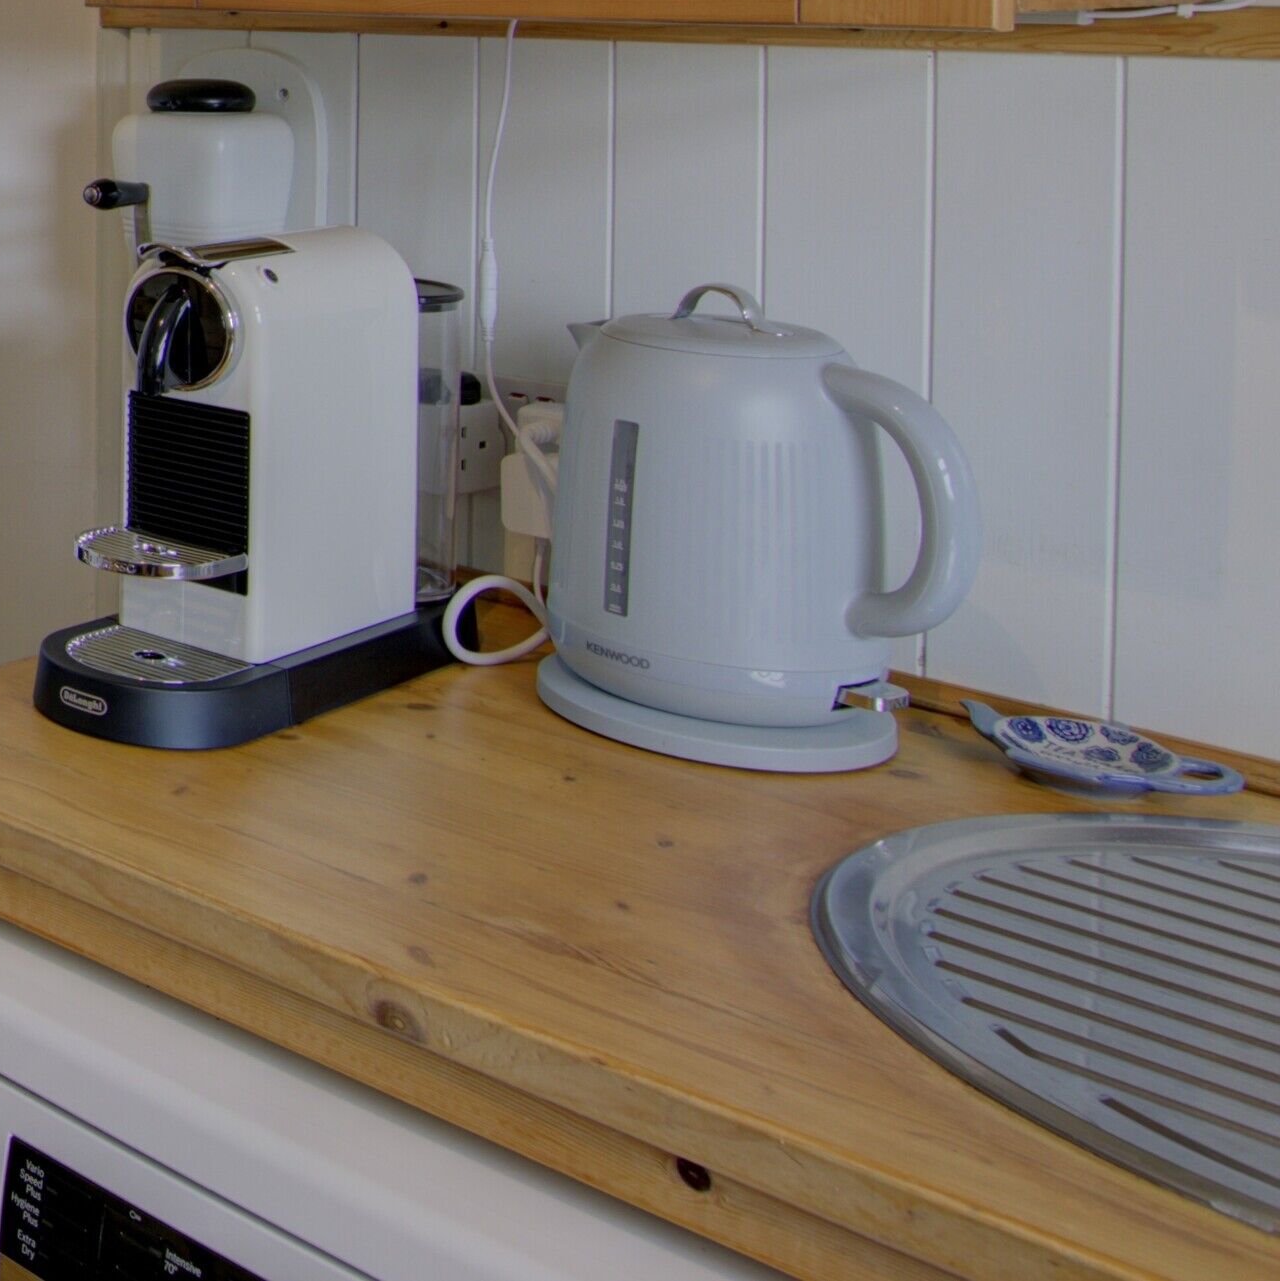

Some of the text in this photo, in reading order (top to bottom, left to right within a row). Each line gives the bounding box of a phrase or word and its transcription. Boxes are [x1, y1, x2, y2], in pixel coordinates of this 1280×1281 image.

[585, 640, 650, 670] KENWOOD
[19, 1168, 44, 1190] Speed
[26, 1159, 45, 1178] Vario
[25, 1184, 42, 1201] Plus
[11, 1191, 40, 1217] Hygiene
[22, 1210, 39, 1228] Plus
[17, 1228, 36, 1249] Extra
[21, 1244, 36, 1261] Dry
[165, 1247, 202, 1278] Intensive
